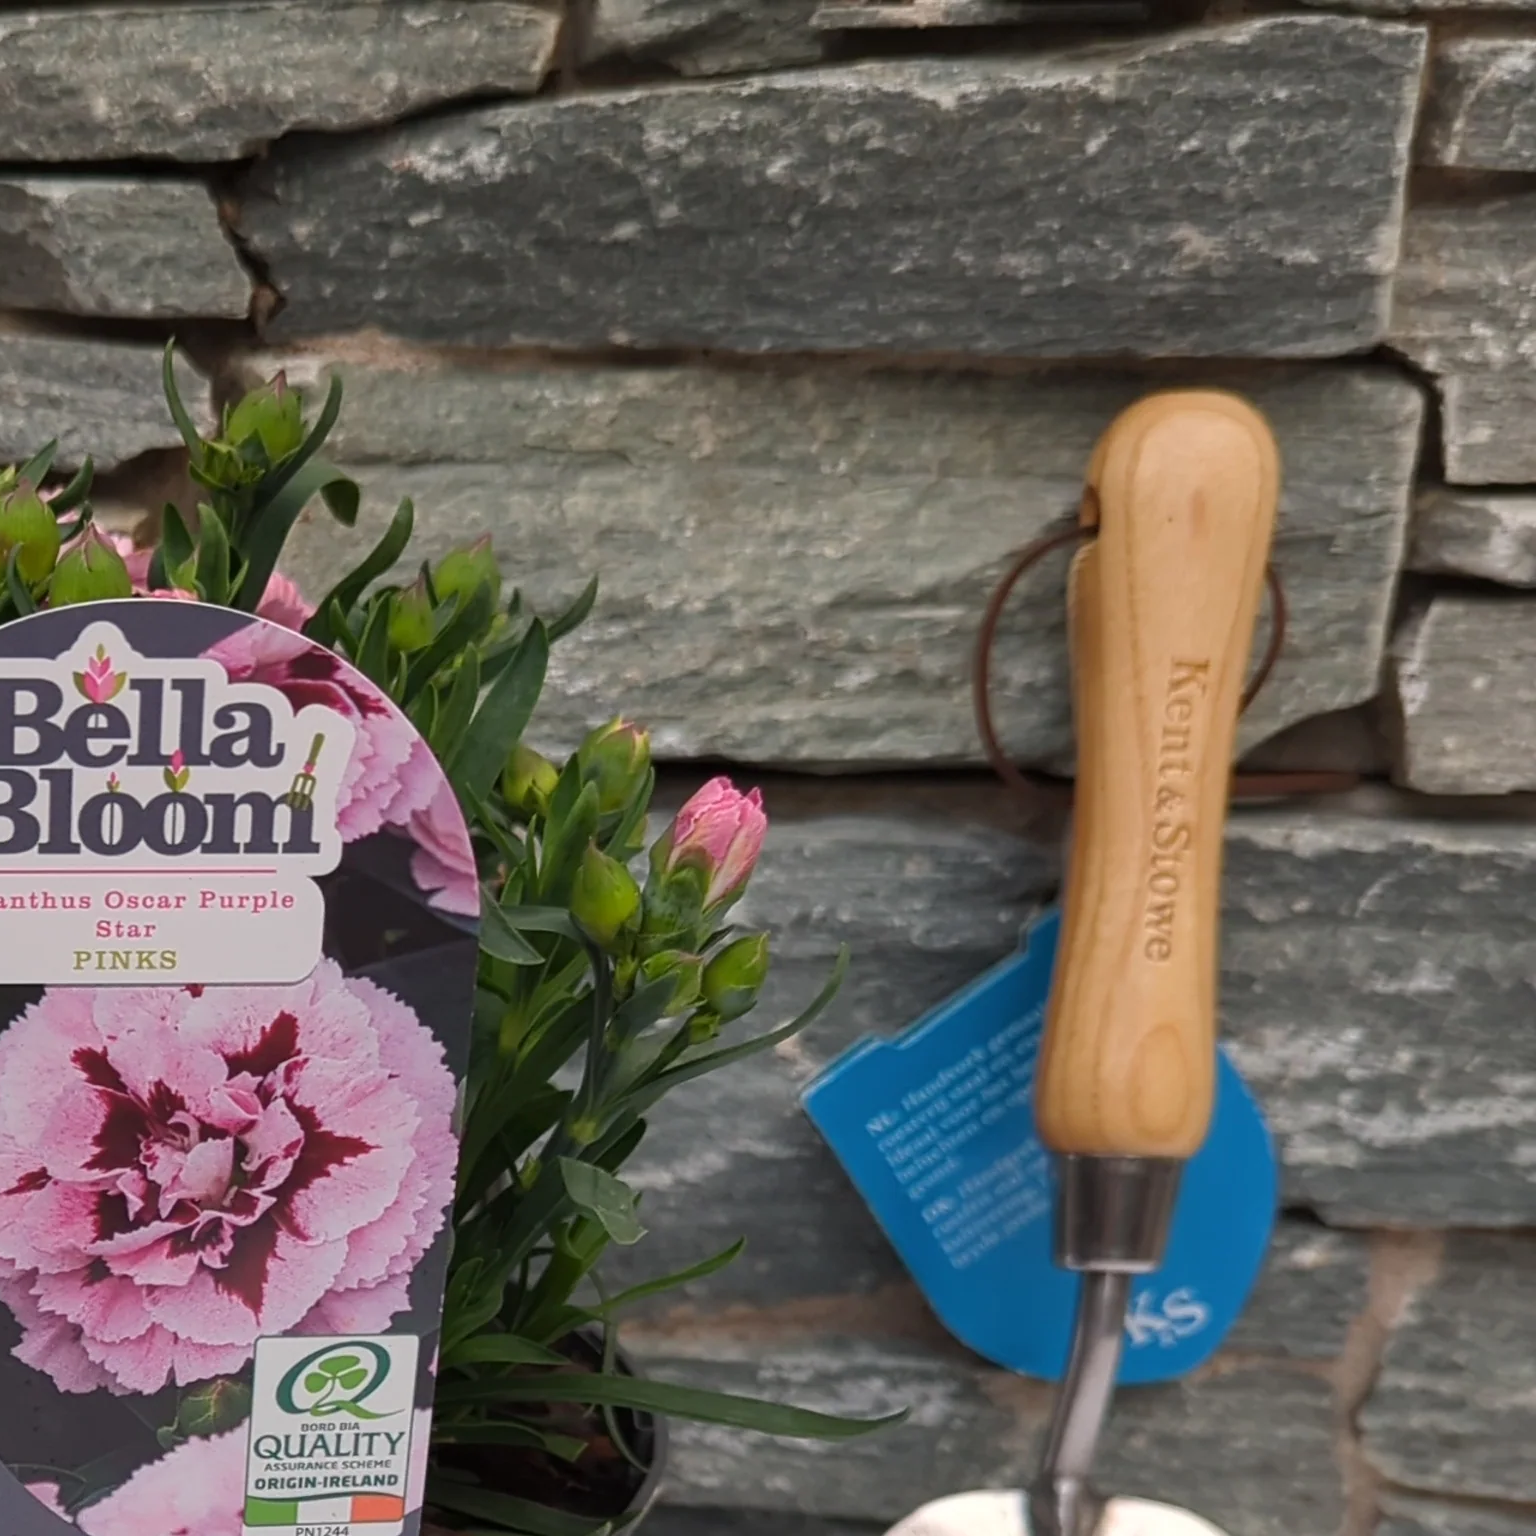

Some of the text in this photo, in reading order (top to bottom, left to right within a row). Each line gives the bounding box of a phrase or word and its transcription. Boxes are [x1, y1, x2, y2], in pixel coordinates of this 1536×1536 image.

[1144, 656, 1210, 964] Kent & Stowe
[104, 891, 187, 910] Oscar
[198, 890, 296, 914] Purple
[95, 919, 157, 938] Star
[72, 950, 178, 971] PINKS
[300, 1422, 360, 1432] BORD BIA
[253, 1431, 406, 1460] QUALITY
[264, 1460, 392, 1472] ASSURANCE SCHEME
[254, 1474, 399, 1490] ORIGIN-IRELAND
